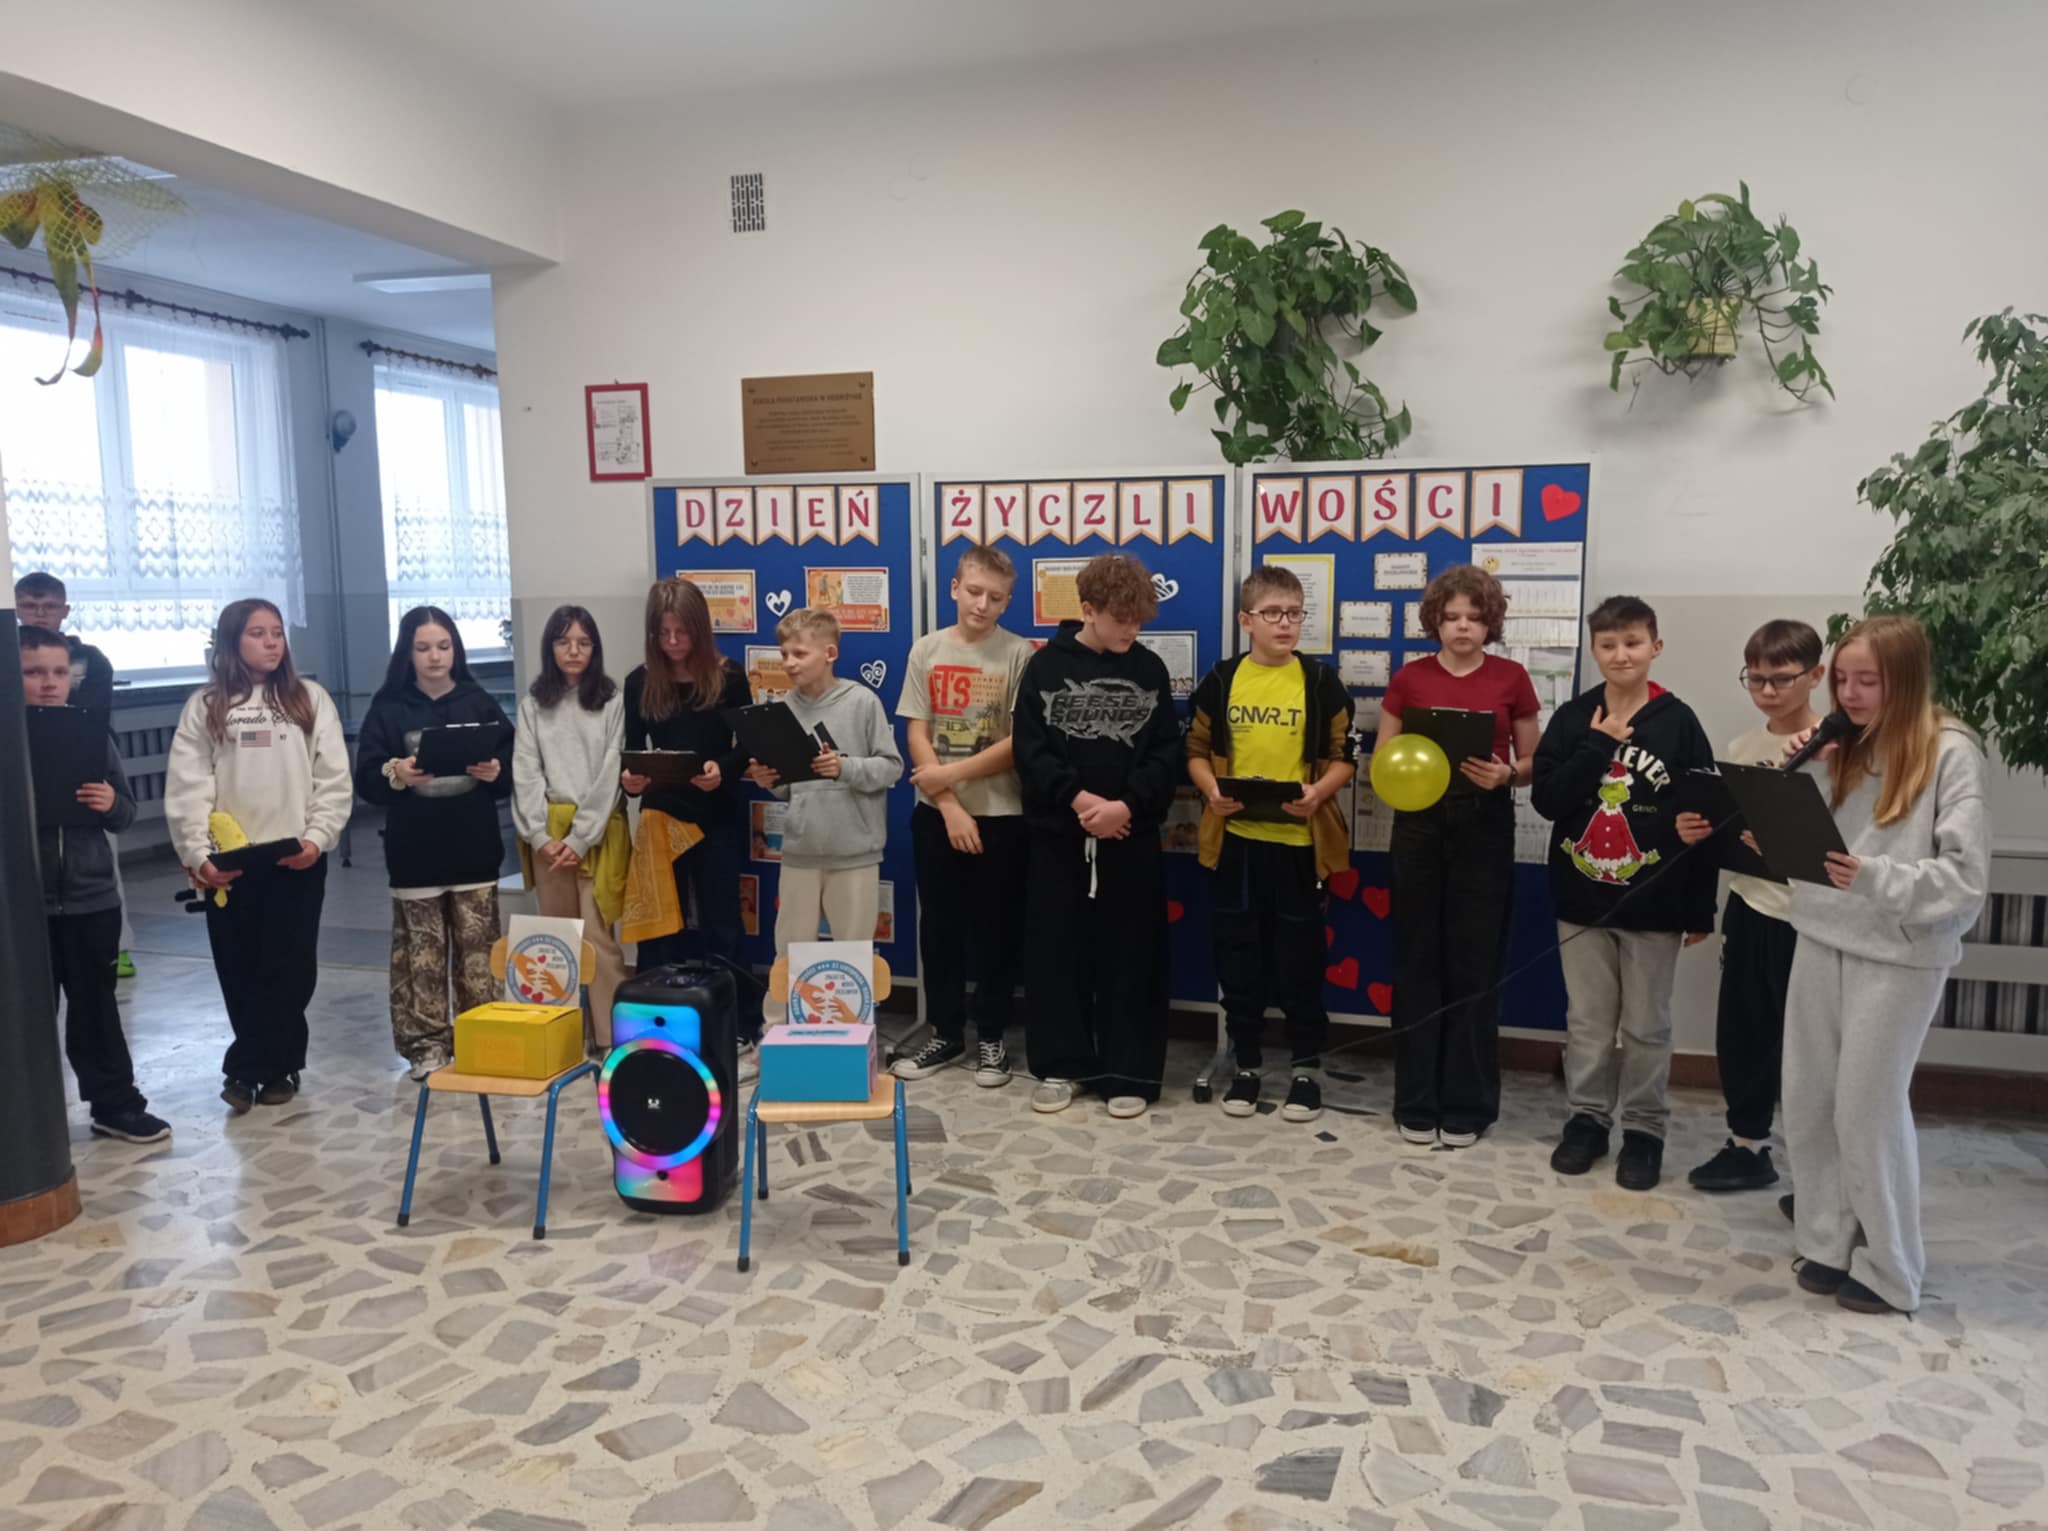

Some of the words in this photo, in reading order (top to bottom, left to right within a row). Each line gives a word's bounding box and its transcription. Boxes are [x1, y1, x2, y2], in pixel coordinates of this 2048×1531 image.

[685, 490, 869, 527] DZIEŃ
[951, 489, 1195, 527] ŻYCZLI
[1260, 479, 1501, 523] WOŚCI
